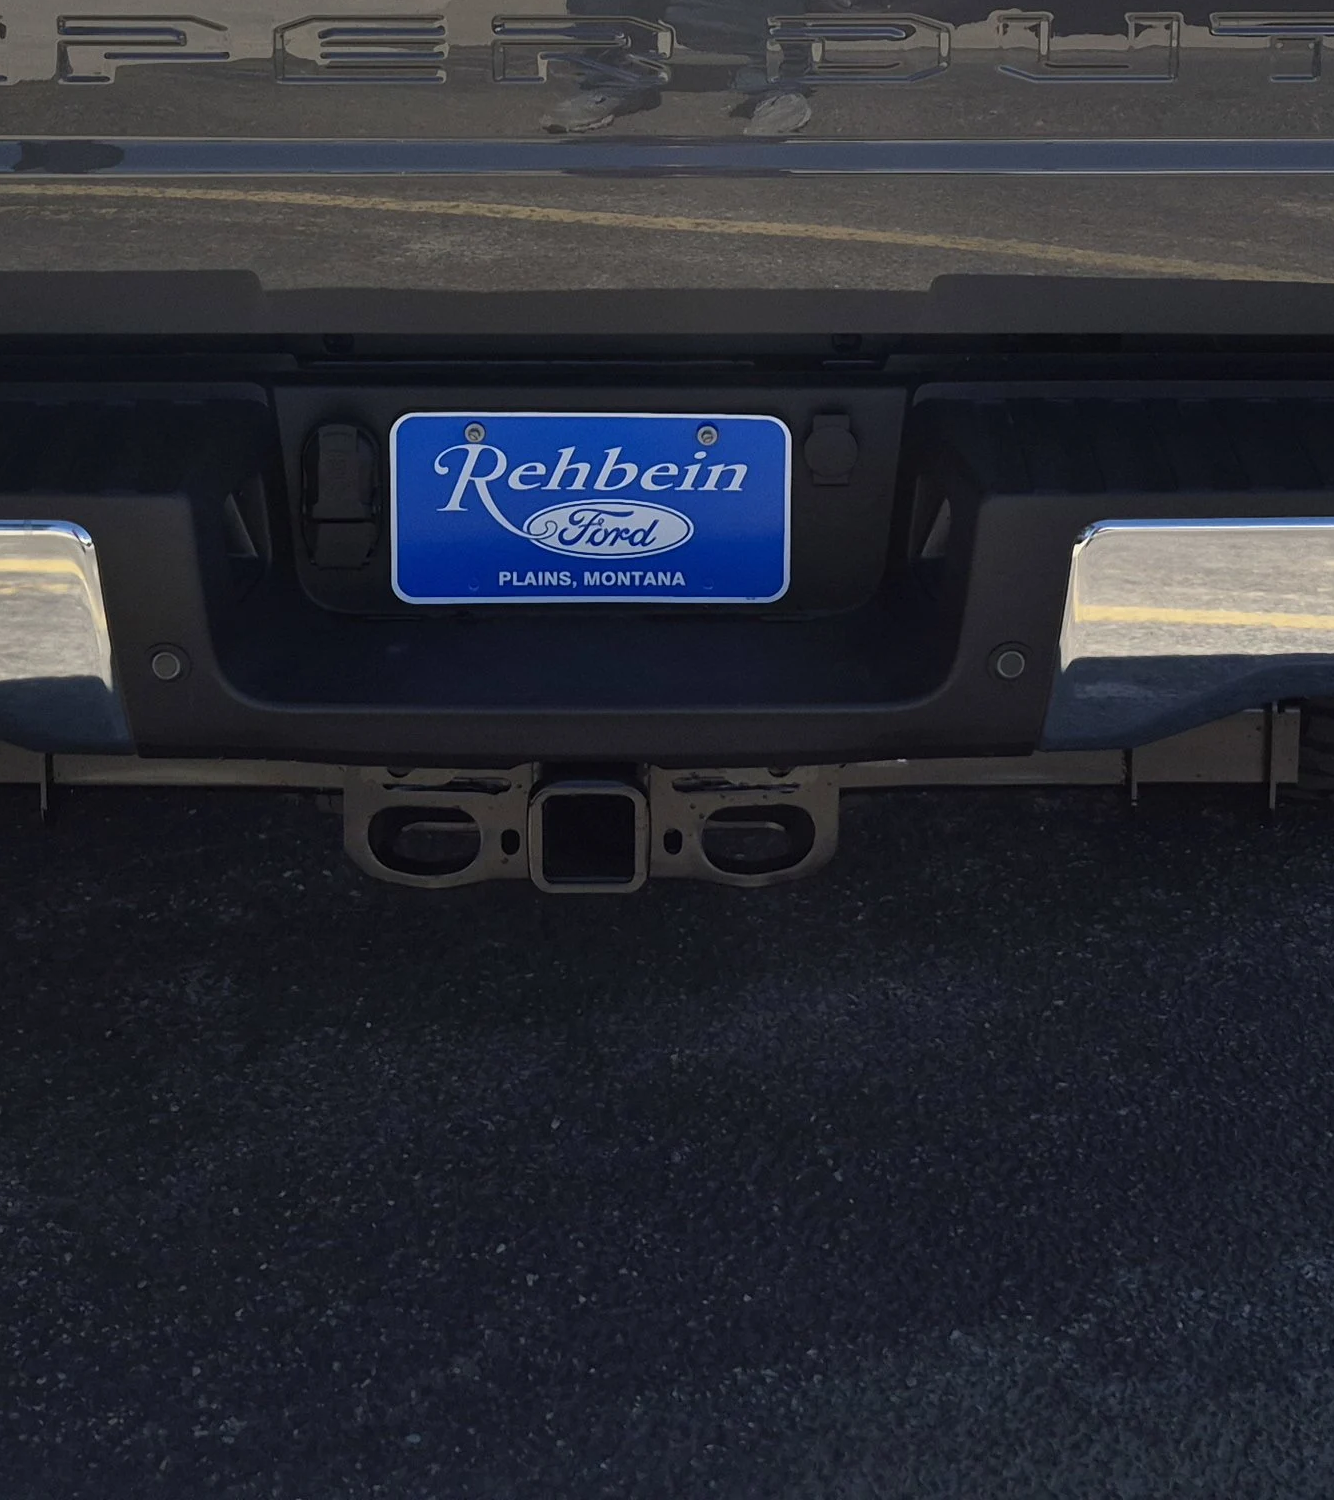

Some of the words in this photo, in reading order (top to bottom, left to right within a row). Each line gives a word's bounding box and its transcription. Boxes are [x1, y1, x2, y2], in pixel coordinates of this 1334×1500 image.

[433, 443, 749, 540] Rehbein
[558, 507, 660, 548] Ford
[498, 571, 578, 590] PLAINS,
[583, 571, 686, 587] MONTANA
